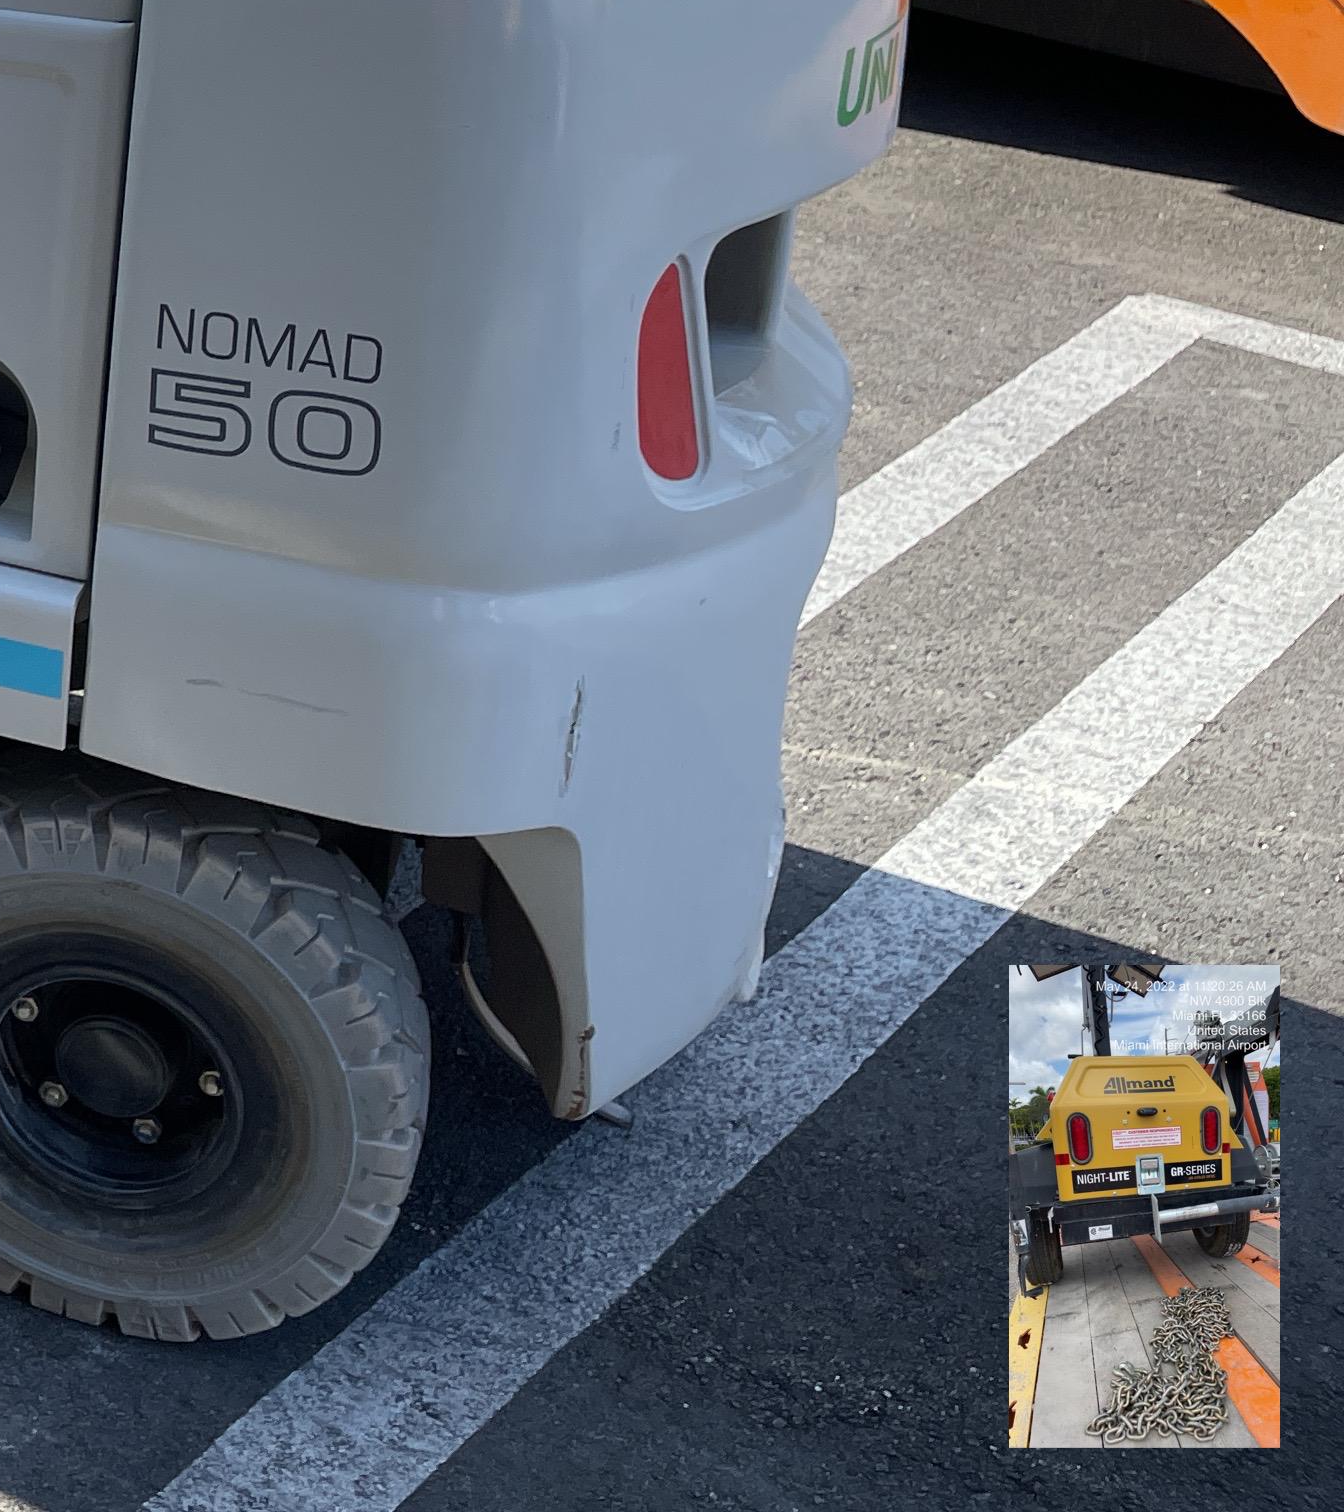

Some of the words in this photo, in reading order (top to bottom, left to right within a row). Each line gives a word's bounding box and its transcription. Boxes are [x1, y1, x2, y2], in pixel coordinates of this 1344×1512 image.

[156, 303, 383, 385] NOMAD
[148, 368, 382, 477] 50
[1104, 1076, 1175, 1094] Allmand
[1077, 1170, 1130, 1185] NIGHT-LITE
[1170, 1163, 1216, 1177] GR-SERIES
